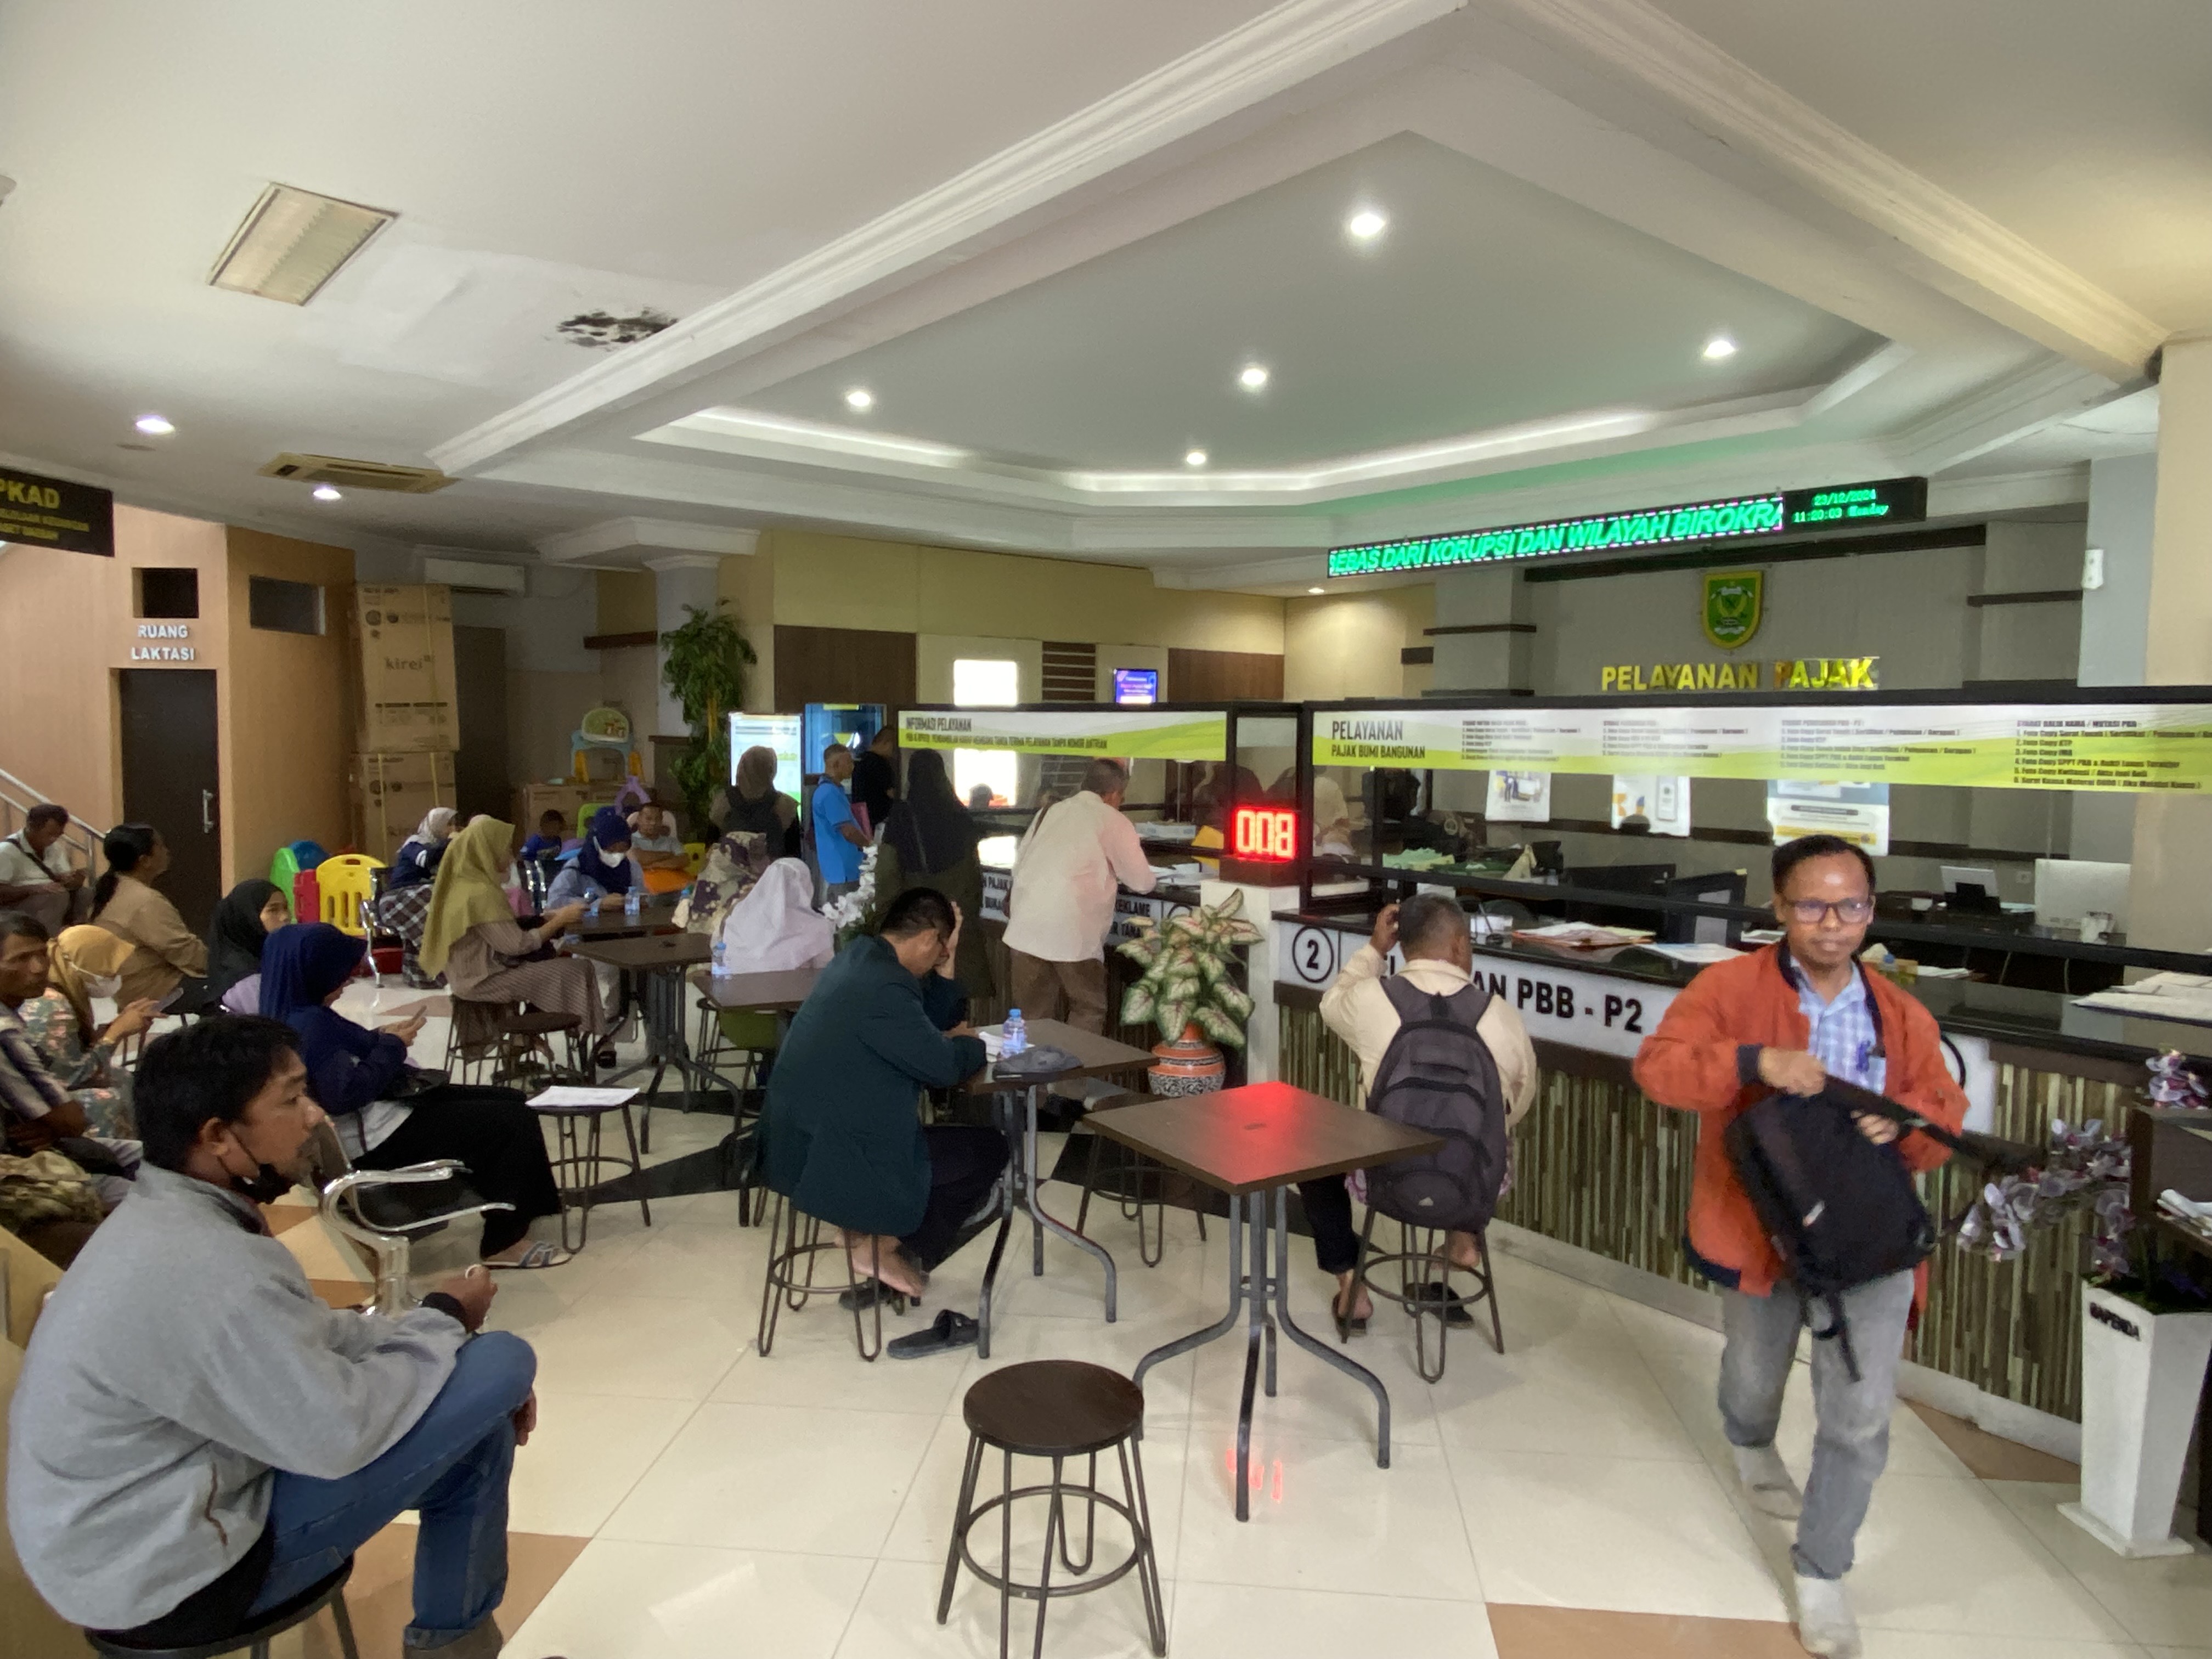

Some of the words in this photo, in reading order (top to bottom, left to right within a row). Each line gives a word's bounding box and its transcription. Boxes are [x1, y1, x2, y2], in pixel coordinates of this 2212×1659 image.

[1848, 503, 1889, 517] Monday
[1381, 544, 1426, 568] DARI
[1426, 534, 1515, 563] KORUPSI
[1516, 527, 1565, 554] DAN
[1567, 515, 1671, 549] WILAYAH
[137, 624, 189, 639] RUANG
[131, 646, 195, 661] LAKTASI
[1601, 663, 1758, 691] PELAYANAN
[1774, 658, 1876, 690] PAJAK
[937, 717, 972, 732] PELAYANAN
[1331, 720, 1403, 741] PELAYANAN
[1331, 744, 1356, 758] PAJAK
[1358, 745, 1379, 758] BUMI
[1380, 746, 1425, 759] BANGUNAN
[1236, 809, 1295, 859] 008
[1306, 939, 1319, 970] 2
[1517, 978, 1575, 1019] PBB
[1604, 994, 1643, 1034] P2
